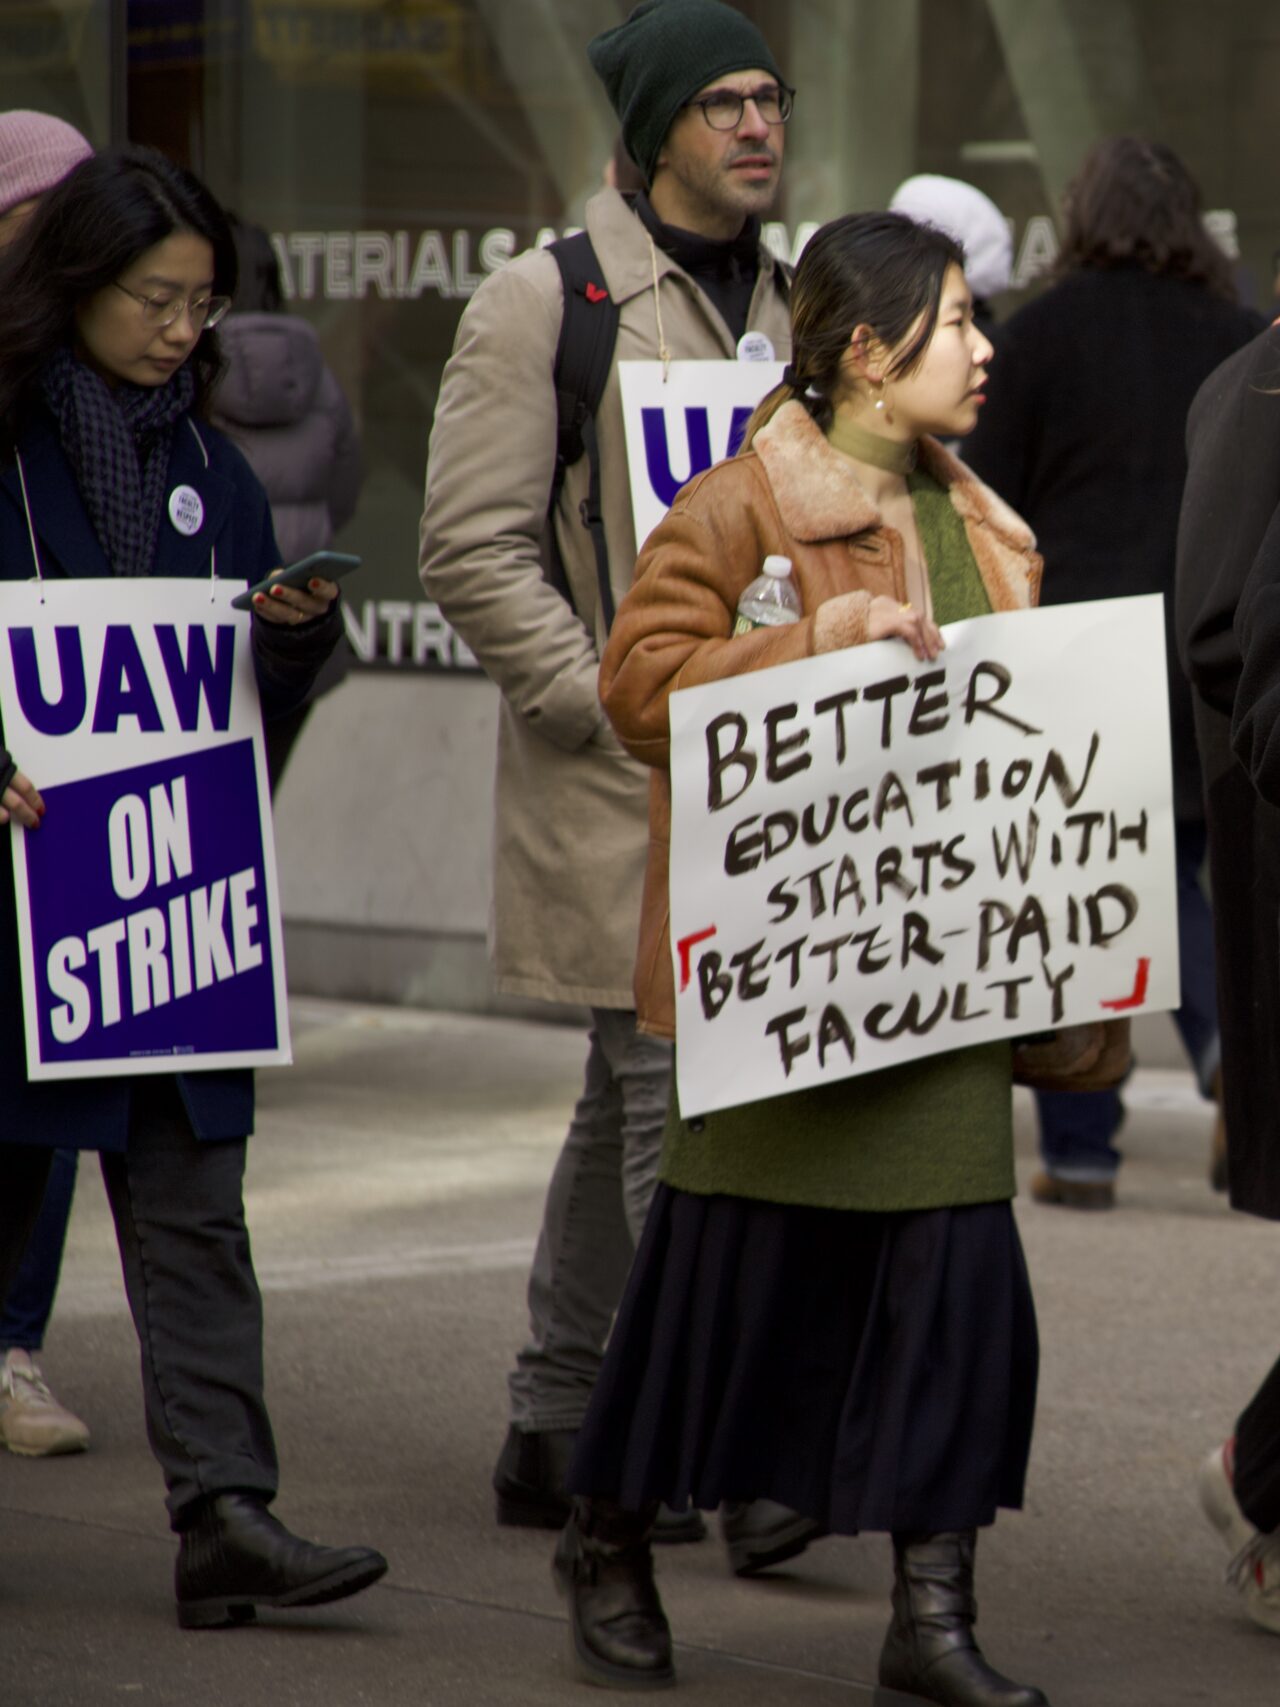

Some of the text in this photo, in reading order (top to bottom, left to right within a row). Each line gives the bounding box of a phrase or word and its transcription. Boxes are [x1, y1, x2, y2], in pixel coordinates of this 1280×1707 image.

[8, 624, 236, 737] UAW
[706, 660, 1043, 813] BETTER
[108, 775, 193, 900] ON
[724, 731, 1099, 877] EDUCATION
[766, 808, 1148, 924] STARTS WITH
[47, 867, 263, 1043] STRIKE
[697, 882, 1138, 1021] BETTER-PAID
[765, 958, 1074, 1078] FACULTY
